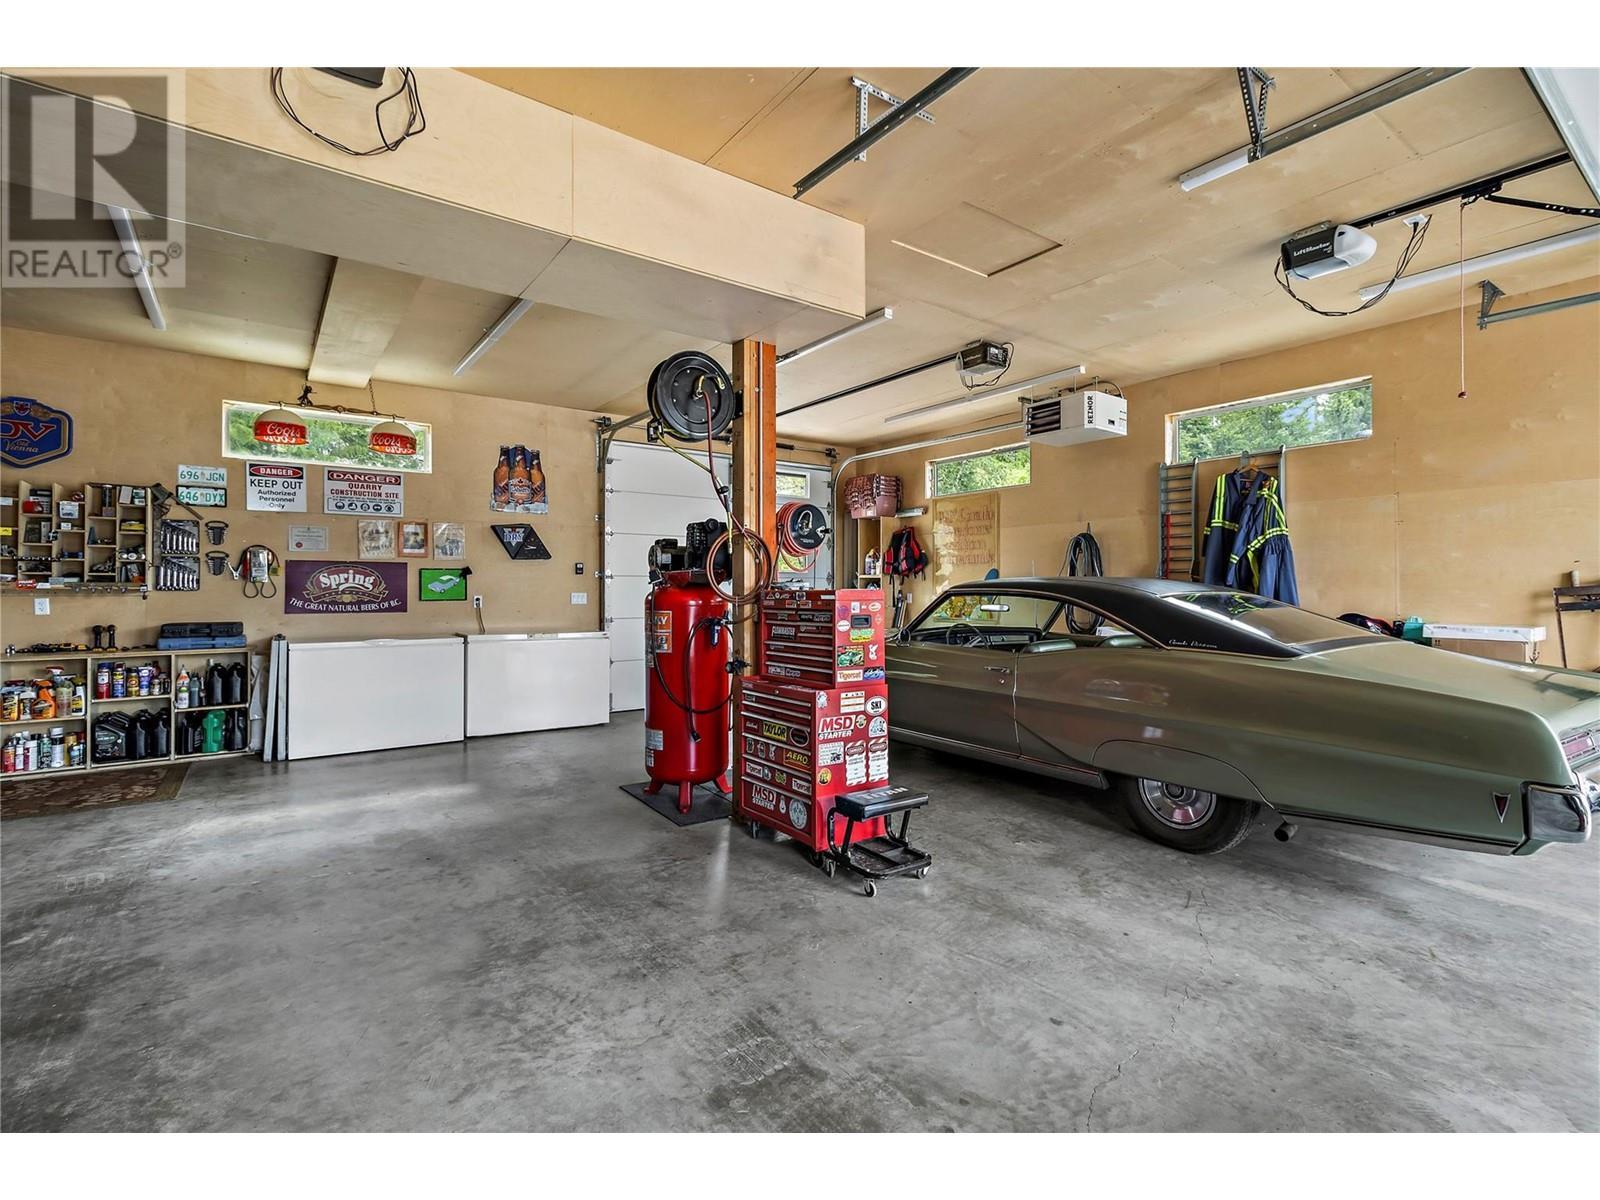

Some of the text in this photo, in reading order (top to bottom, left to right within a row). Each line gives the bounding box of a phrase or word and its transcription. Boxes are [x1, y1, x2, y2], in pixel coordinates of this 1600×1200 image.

[1293, 241, 1331, 257] LiftMaster
[266, 422, 301, 437] Coors
[5, 439, 39, 452] Vienna
[372, 433, 401, 447] Coors
[180, 470, 225, 482] 696 JGN
[260, 467, 293, 476] DANGER
[333, 472, 395, 483] DANGER
[249, 478, 303, 490] KEEP OUT
[348, 482, 382, 491] QUARRY
[179, 491, 224, 503] 646 DYX
[257, 489, 296, 497] Authorized
[330, 488, 382, 498] CONSTRUCTION
[319, 569, 376, 591] Spring
[289, 597, 303, 608] THE
[304, 602, 327, 611] GREAT
[328, 604, 360, 612] NATURAL
[361, 602, 379, 611] BEERS
[380, 601, 390, 609] OF
[839, 671, 861, 680] Tigercat
[870, 700, 882, 710] SKI
[763, 722, 787, 737] TAYLOR
[820, 716, 854, 732] MSD
[819, 730, 852, 739] STARTER
[786, 751, 808, 765] AERO
[752, 784, 777, 804] MSD
[752, 797, 775, 811] STARTER
